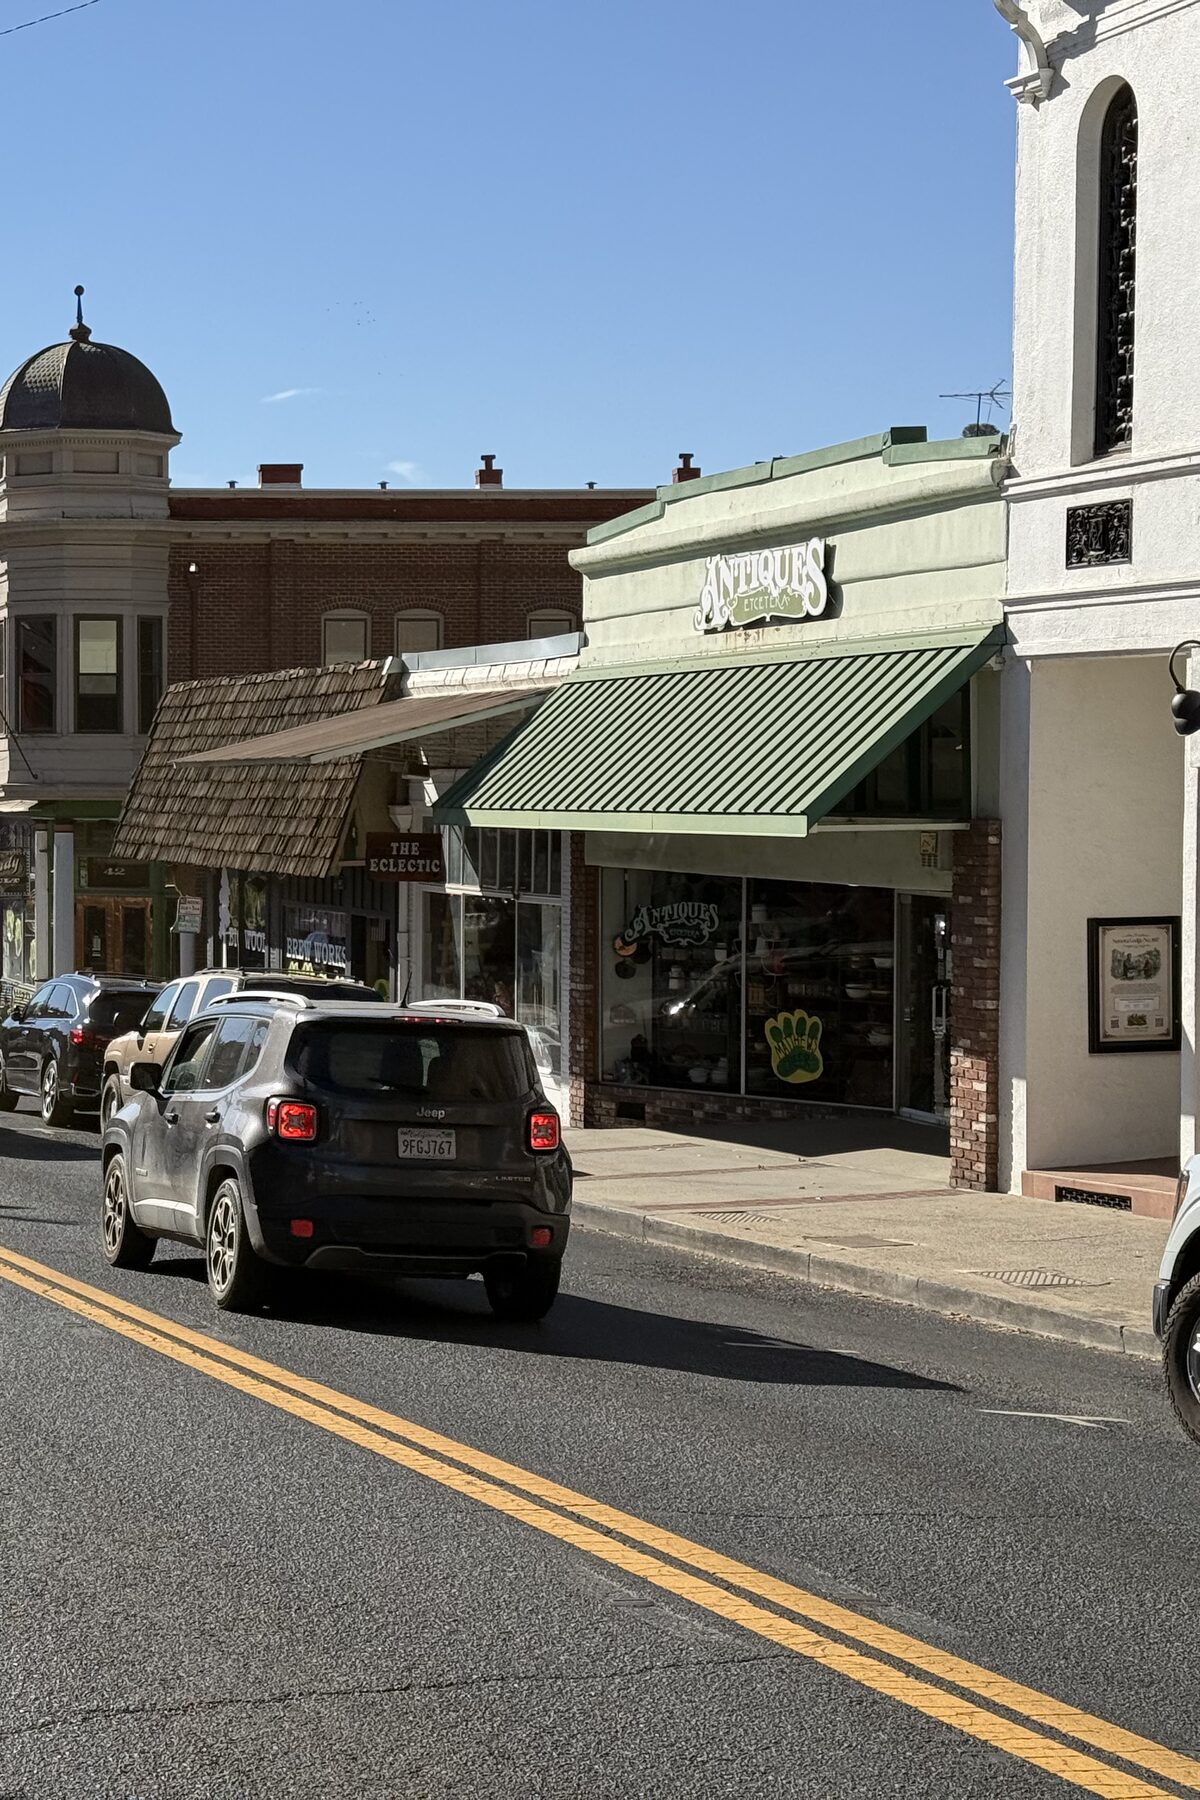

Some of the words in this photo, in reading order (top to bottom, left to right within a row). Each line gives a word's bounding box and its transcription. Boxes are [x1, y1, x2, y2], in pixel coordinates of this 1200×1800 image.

[693, 536, 828, 632] ANTIQUES
[743, 594, 791, 612] ETCETERA
[390, 842, 420, 856] THE
[103, 867, 126, 877] 42
[369, 858, 440, 873] ECLECTIC
[624, 901, 719, 942] ANTIQUES
[286, 937, 312, 962] BREW
[313, 941, 347, 969] WORKS
[416, 1106, 446, 1120] Jeep
[401, 1139, 453, 1155] 9FGJ767
